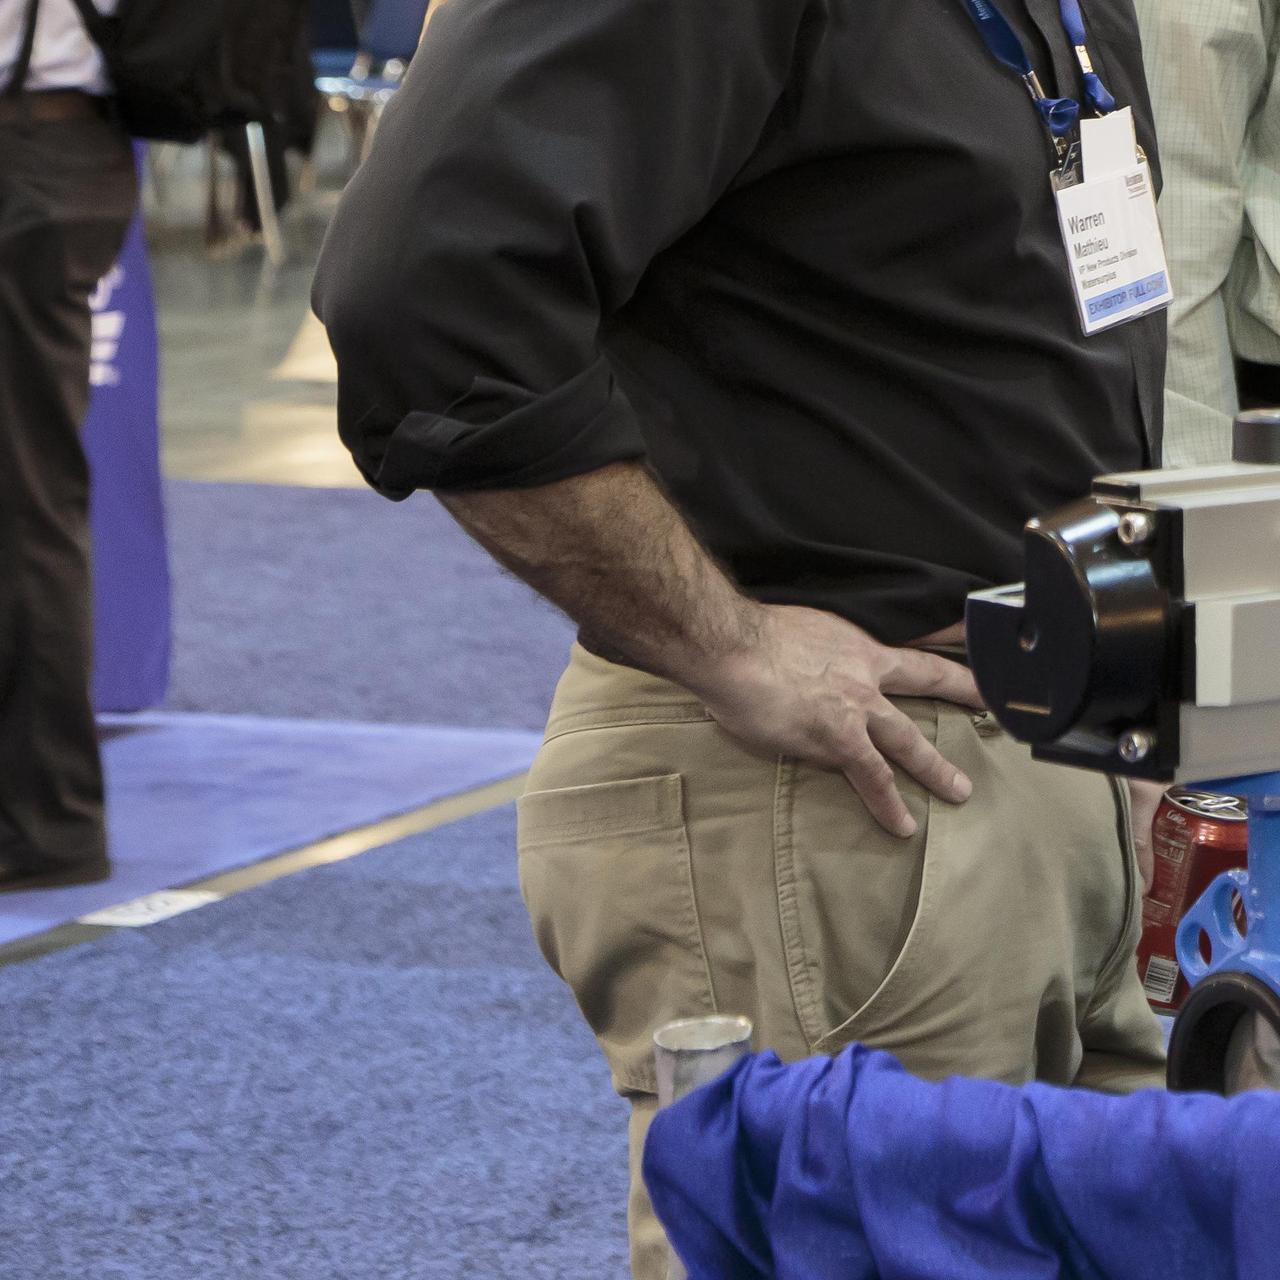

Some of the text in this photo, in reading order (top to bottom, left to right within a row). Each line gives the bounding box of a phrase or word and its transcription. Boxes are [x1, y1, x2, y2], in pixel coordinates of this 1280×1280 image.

[1068, 211, 1105, 235] Warren
[1073, 236, 1109, 259] Mathieu
[1088, 291, 1128, 315] EXHIBITOR
[1128, 284, 1146, 298] FULL
